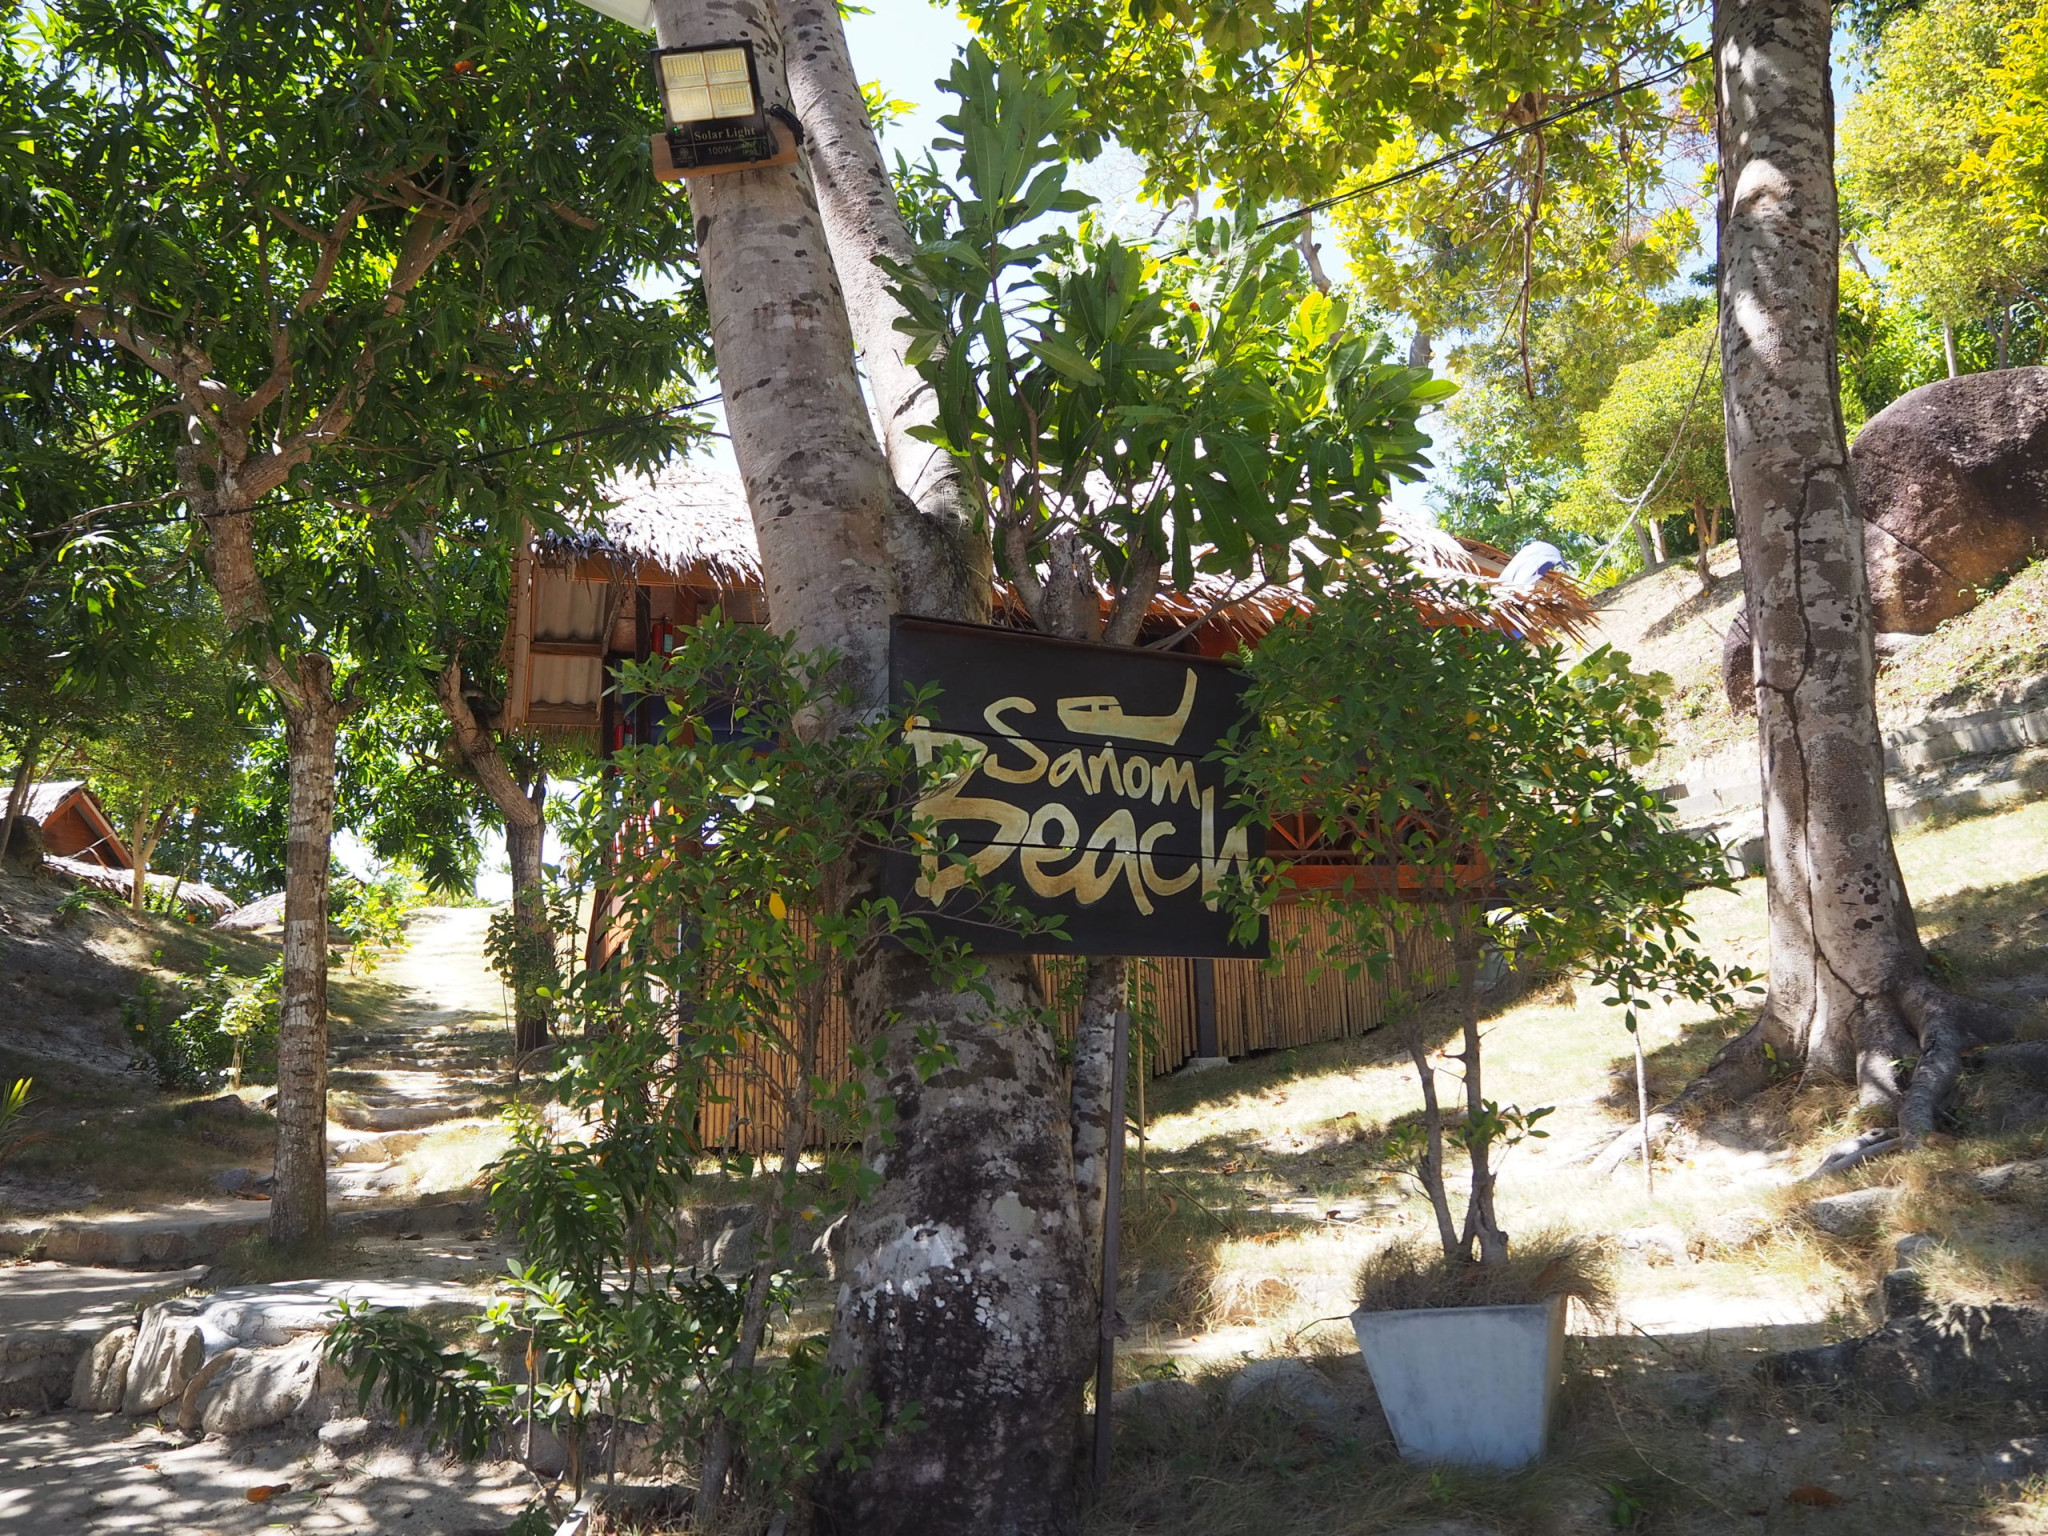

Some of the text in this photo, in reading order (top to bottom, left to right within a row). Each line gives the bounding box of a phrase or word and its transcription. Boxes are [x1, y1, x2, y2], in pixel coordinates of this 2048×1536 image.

[694, 129, 724, 141] Solar
[725, 126, 756, 140] Light
[708, 145, 733, 156] 100W
[901, 715, 1269, 915] Beach
